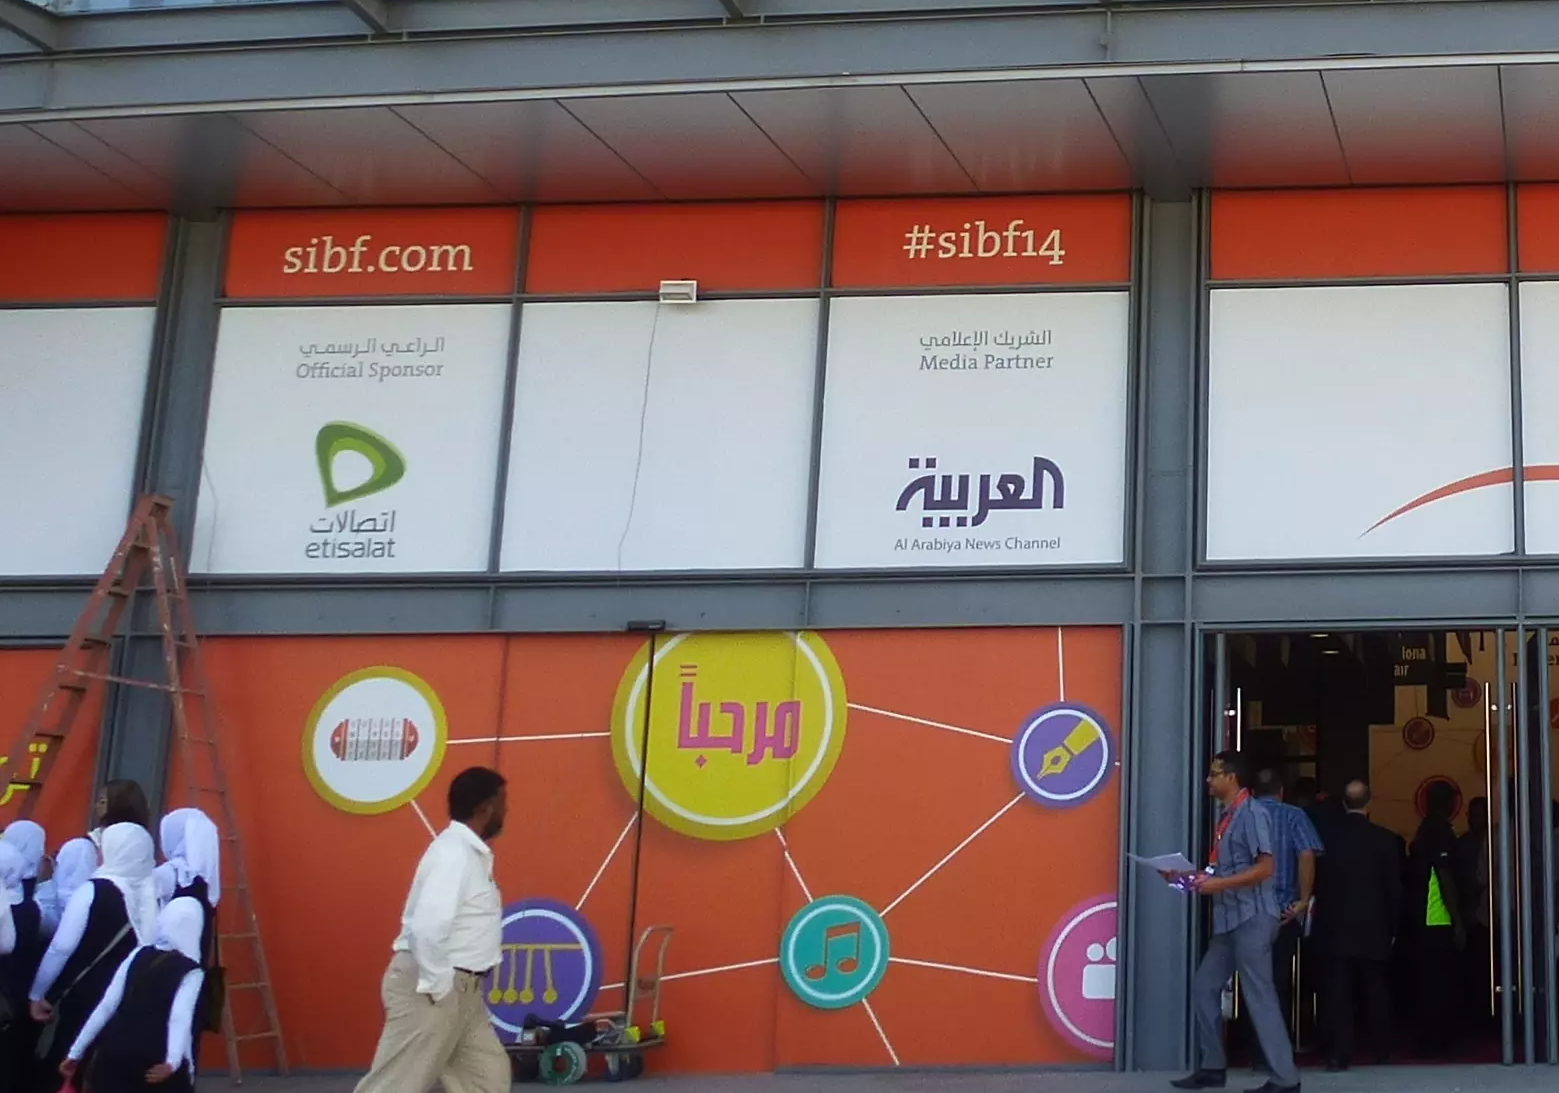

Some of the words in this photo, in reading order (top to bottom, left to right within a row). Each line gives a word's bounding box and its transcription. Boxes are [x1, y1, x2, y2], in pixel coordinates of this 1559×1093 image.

[903, 219, 1066, 265] #sibf14
[283, 235, 473, 273] sibf.com
[299, 337, 377, 358] الرسمي
[381, 336, 445, 357] الراعي
[994, 330, 1051, 350] الشريك
[296, 361, 363, 378] Official
[368, 362, 444, 382] Sponsor
[919, 354, 978, 370] Media
[984, 354, 1054, 369] Partner
[895, 455, 1065, 527] العربية
[309, 509, 396, 535] اتصالات
[305, 538, 396, 559] etisalat
[894, 538, 908, 550] Al
[911, 538, 961, 553] Arabiya
[965, 538, 1001, 550] News
[1004, 537, 1061, 550] Channel
